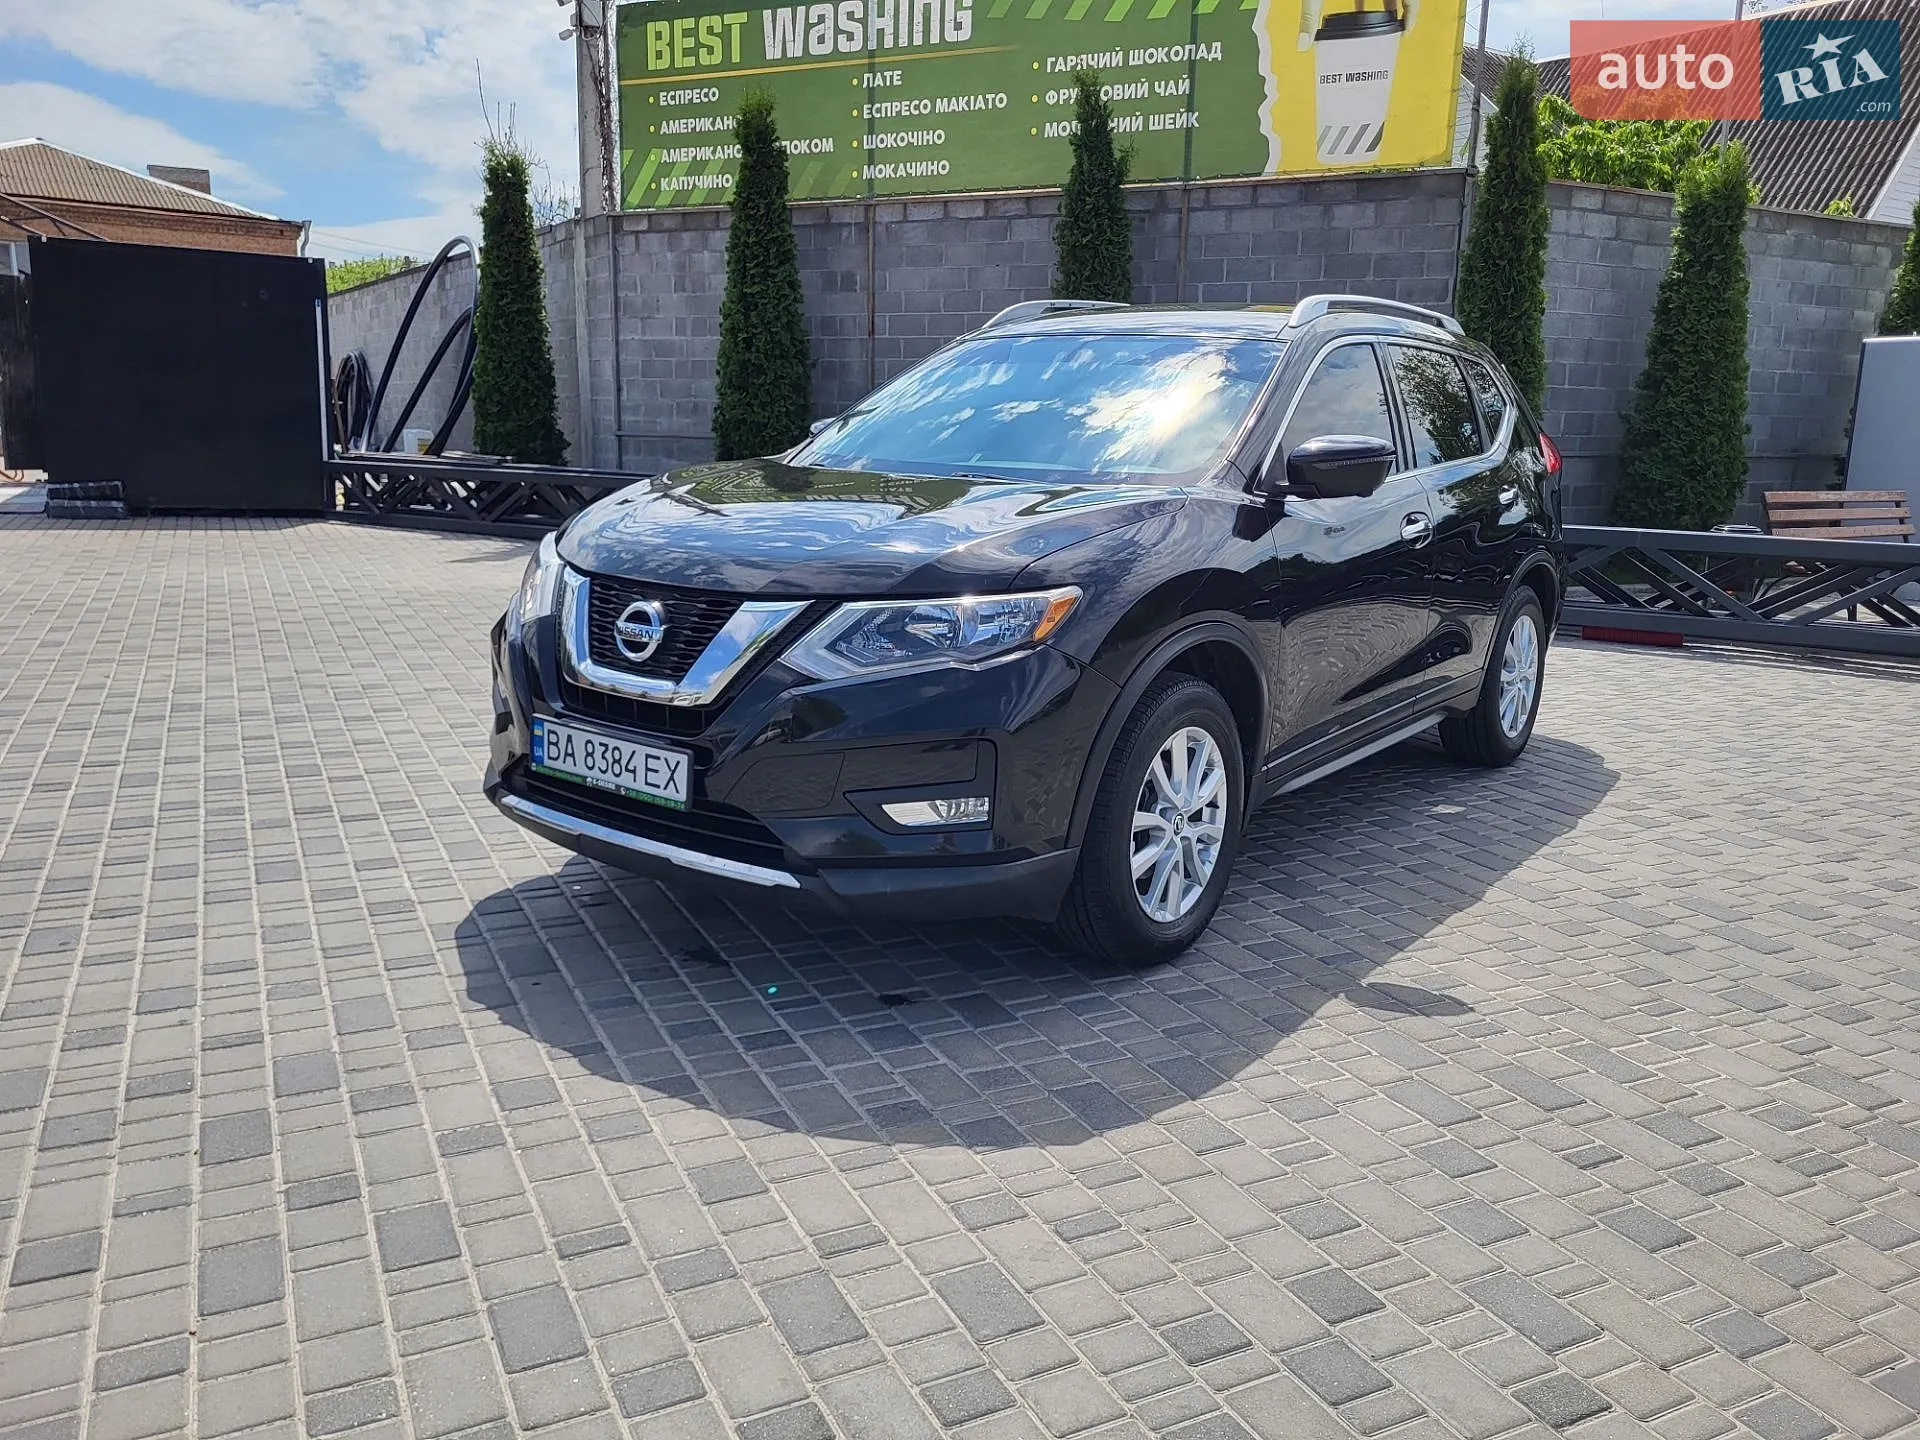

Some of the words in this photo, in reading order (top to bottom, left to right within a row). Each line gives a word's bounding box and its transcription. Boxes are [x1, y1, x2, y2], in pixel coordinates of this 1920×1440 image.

[647, 12, 748, 71] BEST
[1046, 47, 1123, 73] ГАРЯЧИЙ
[1128, 42, 1222, 66] ШОКОЛАД
[863, 70, 902, 88] ЛАТЕ
[1320, 73, 1342, 84] BEST
[659, 87, 719, 106] ЕСПРЕСО
[1045, 78, 1149, 105] ФРУОВИЙ
[1154, 74, 1191, 96] ЧАЙ
[863, 99, 931, 119] ЕСПРЕСО
[935, 92, 1008, 114] МАКІАТО
[1044, 111, 1144, 138] МОЛНИЙ
[1149, 108, 1200, 131] ШЕЙК
[863, 129, 946, 149] ШОКОЧІНО
[661, 144, 743, 163] АМЕРИКАНО
[863, 160, 950, 180] МОКАЧИНО
[660, 173, 733, 192] КАПУЧИНО
[616, 624, 655, 641] NISSAN
[534, 746, 543, 757] UA
[547, 729, 577, 768] BA
[584, 740, 637, 783] 8384
[644, 754, 681, 795] EX
